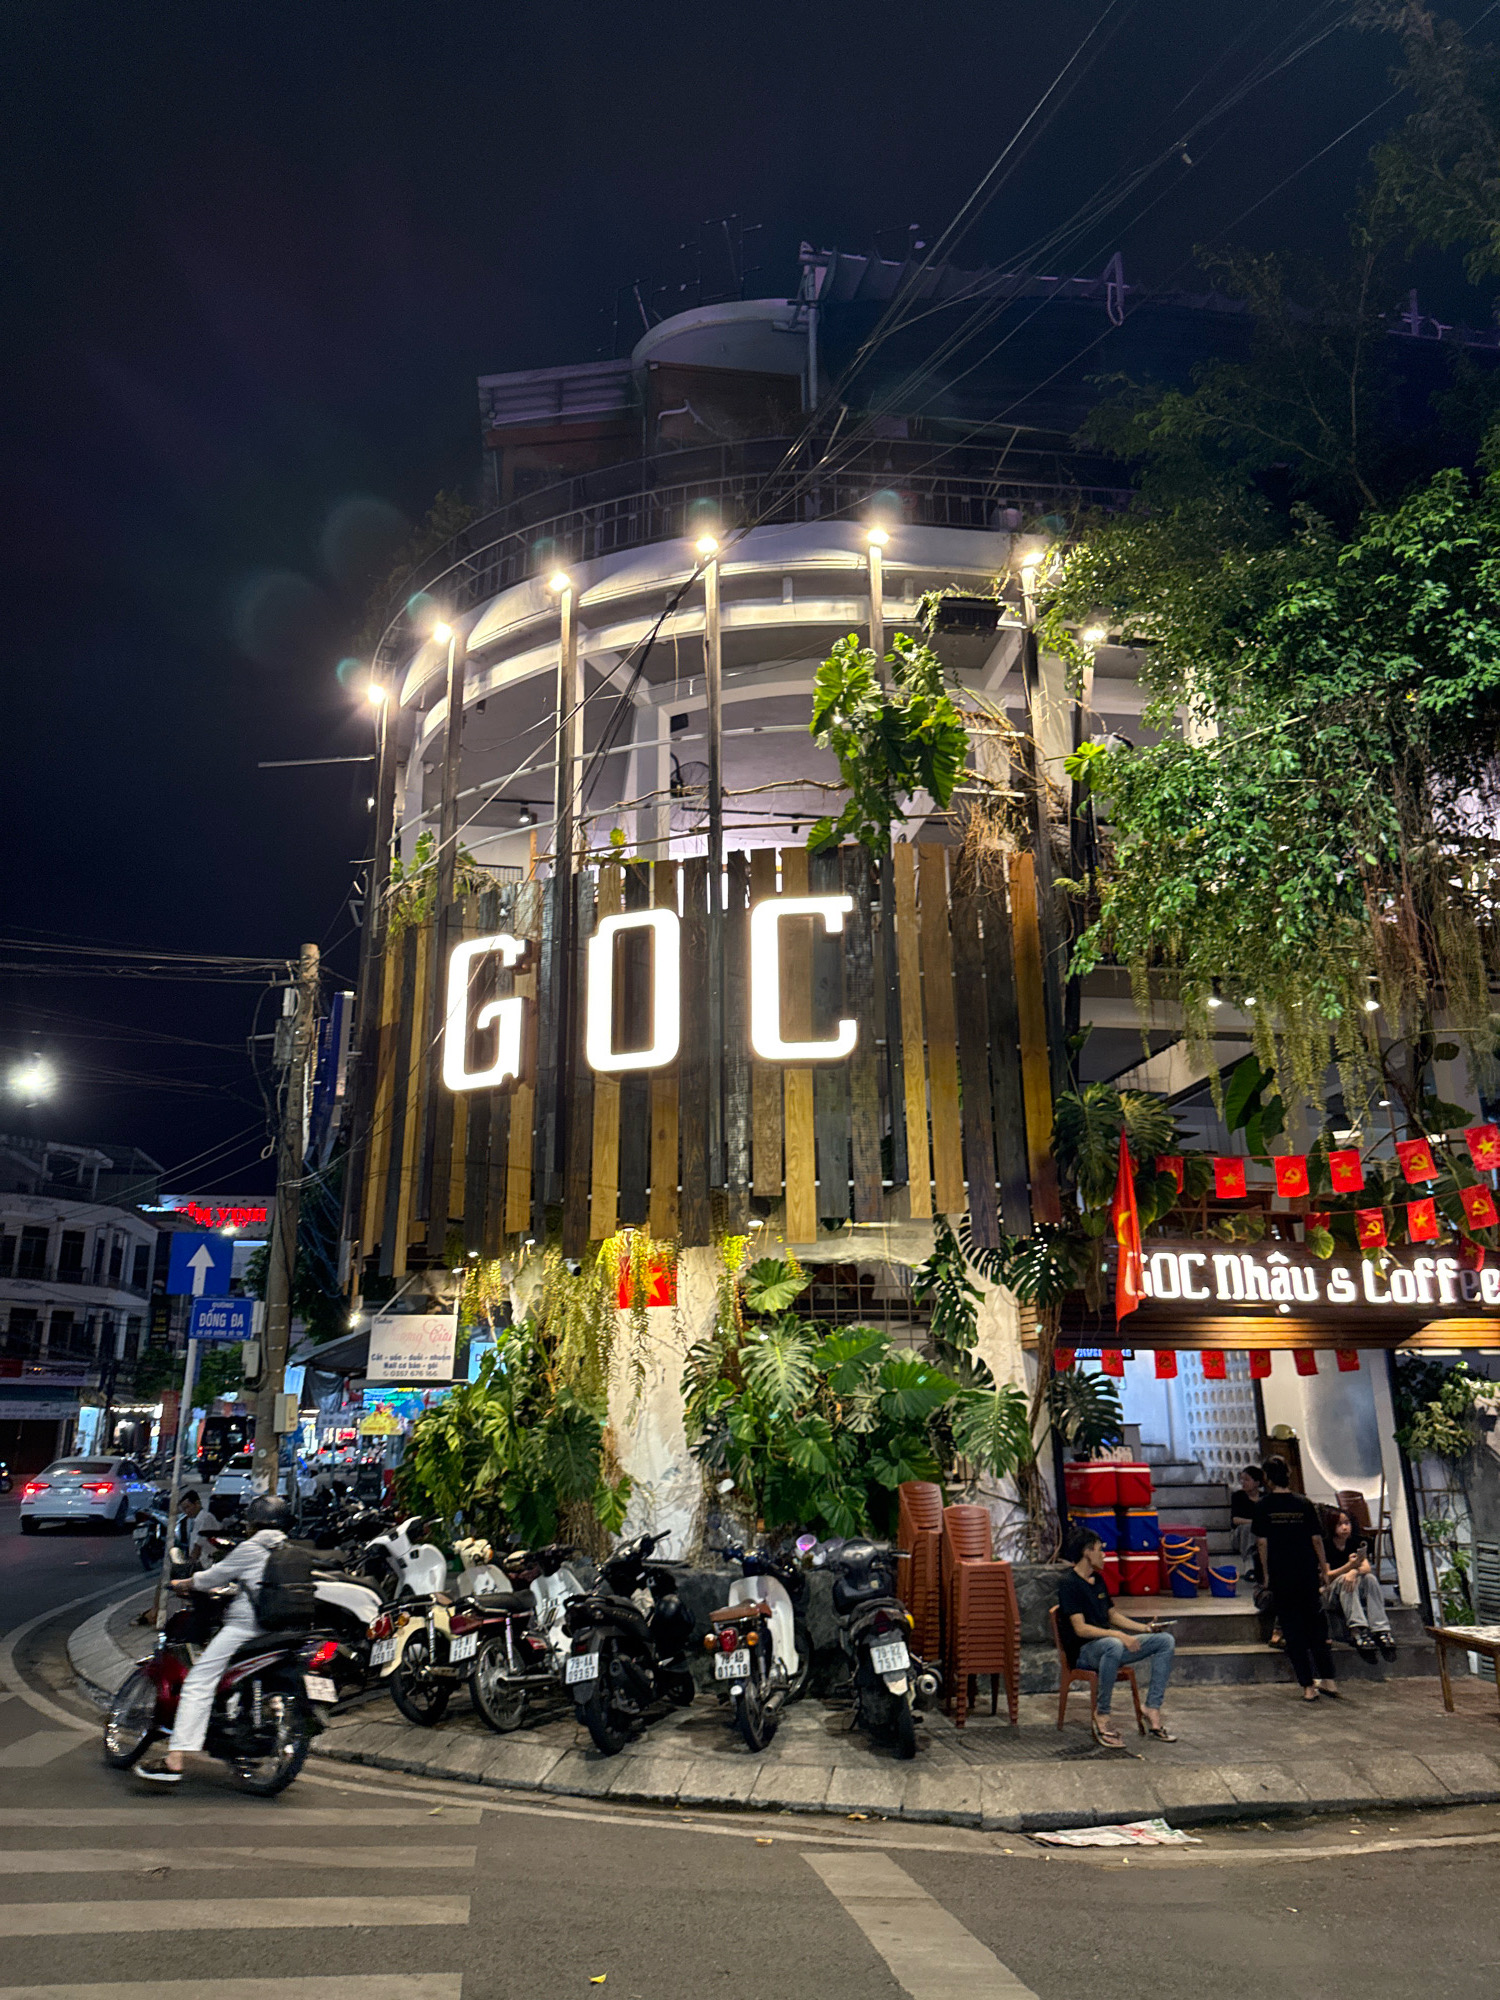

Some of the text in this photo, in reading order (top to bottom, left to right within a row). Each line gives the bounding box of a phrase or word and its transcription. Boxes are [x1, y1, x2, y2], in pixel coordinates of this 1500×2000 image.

[443, 895, 858, 1091] GOC
[1212, 1251, 1319, 1314] Nhậu
[230, 1313, 244, 1328] ĐA
